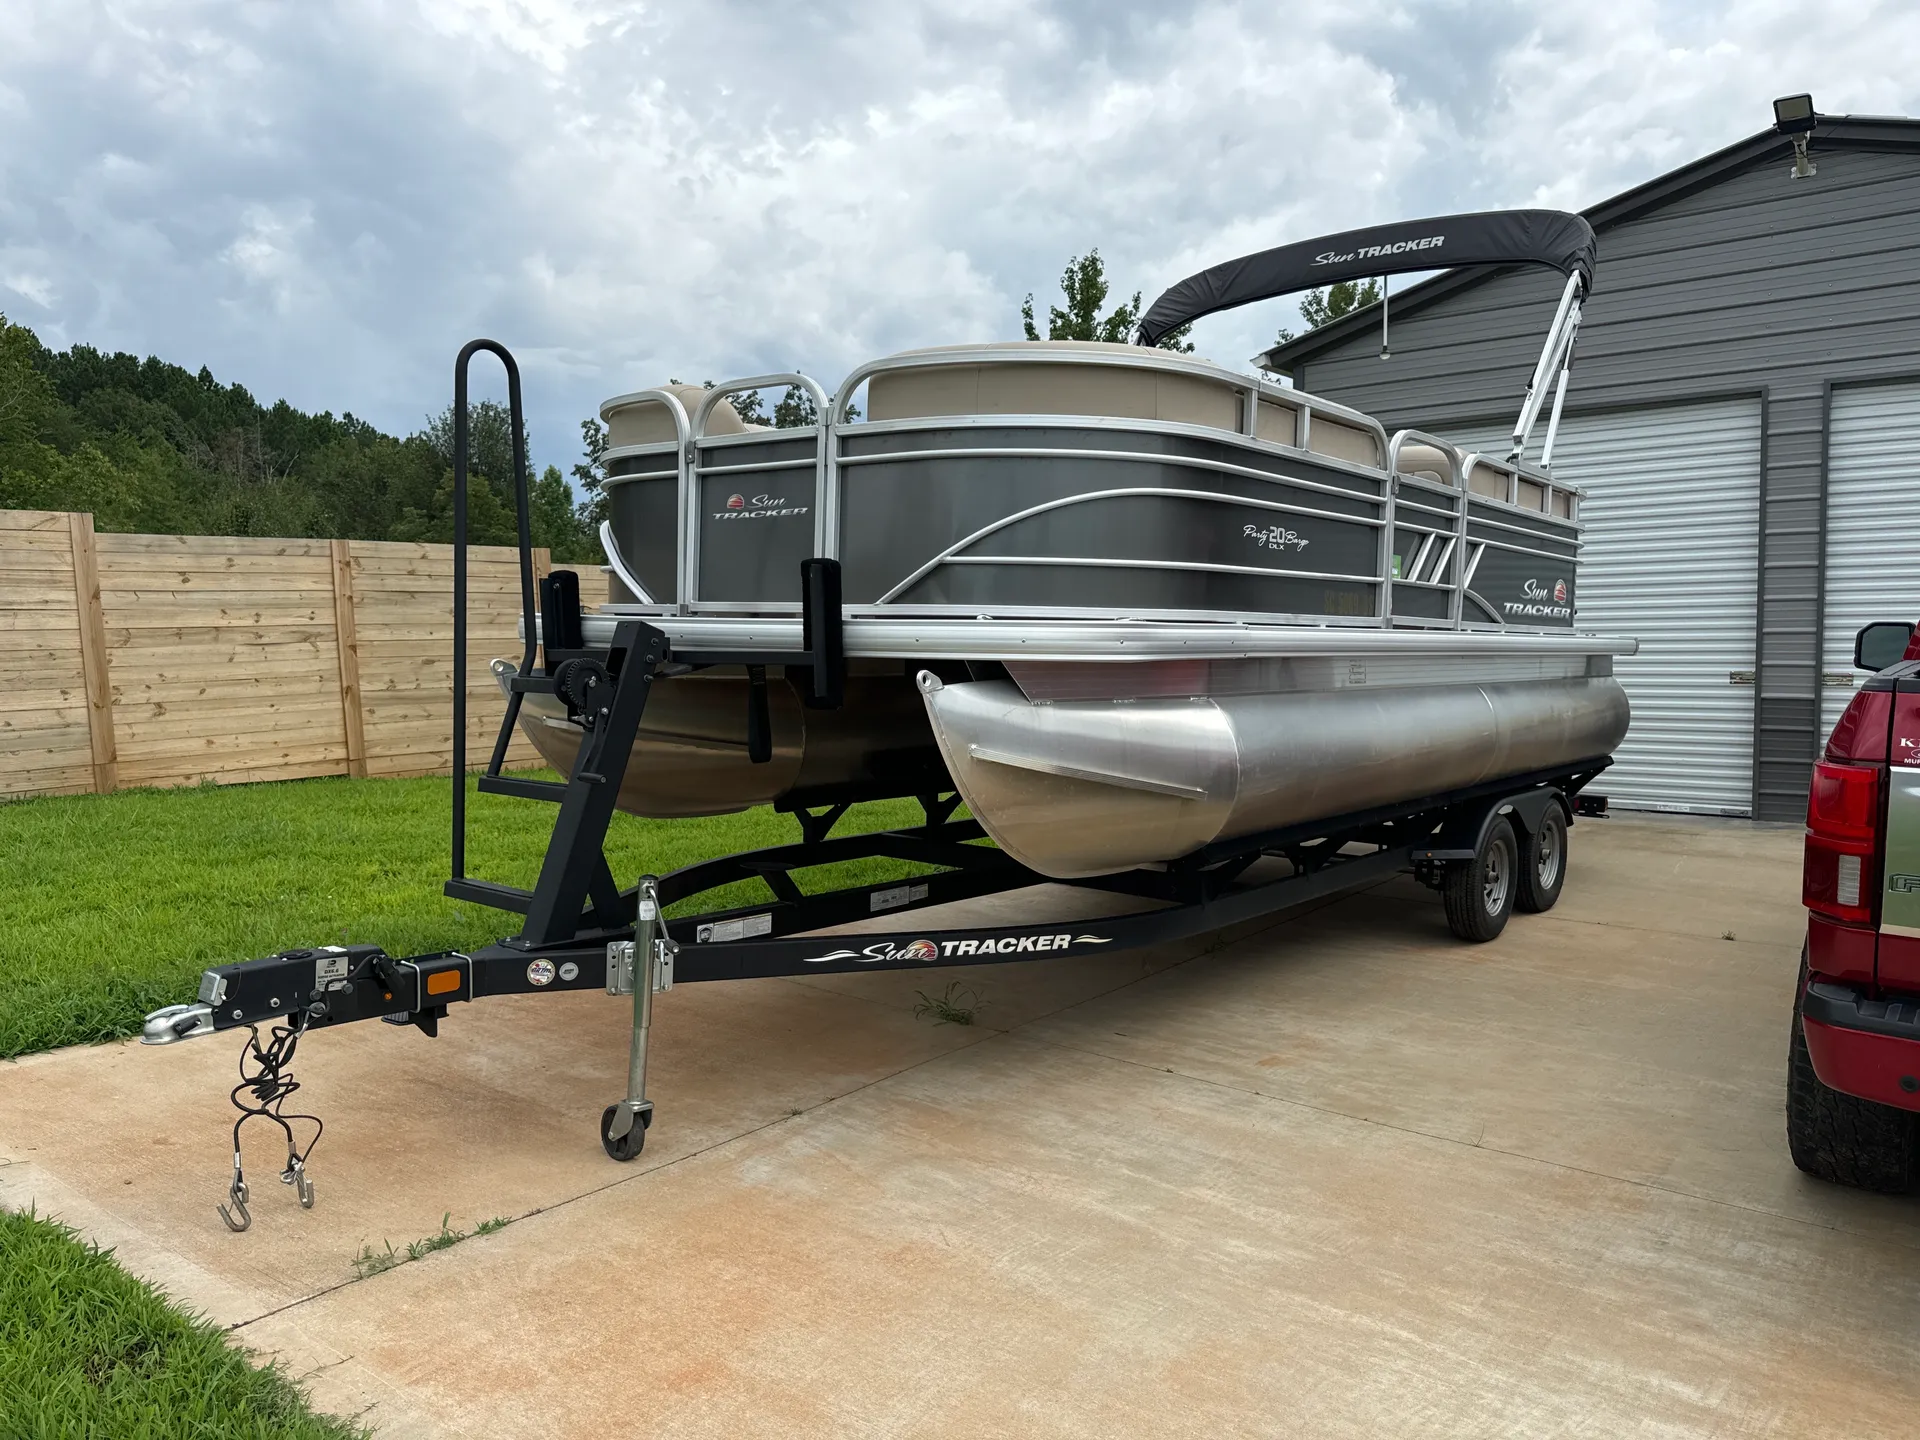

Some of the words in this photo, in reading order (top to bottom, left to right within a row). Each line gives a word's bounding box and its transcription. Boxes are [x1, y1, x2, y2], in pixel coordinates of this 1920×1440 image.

[1310, 251, 1356, 266] Sun
[1357, 236, 1445, 259] TRACKER
[747, 494, 787, 509] Sun
[712, 507, 809, 520] TRACKER
[1243, 524, 1270, 546] Party
[1269, 526, 1286, 543] 20
[1285, 531, 1310, 552] Barge
[1520, 579, 1548, 600] Sun
[1503, 602, 1571, 618] TRACKER
[852, 942, 931, 962] Sun
[940, 934, 1072, 957] TRACKER
